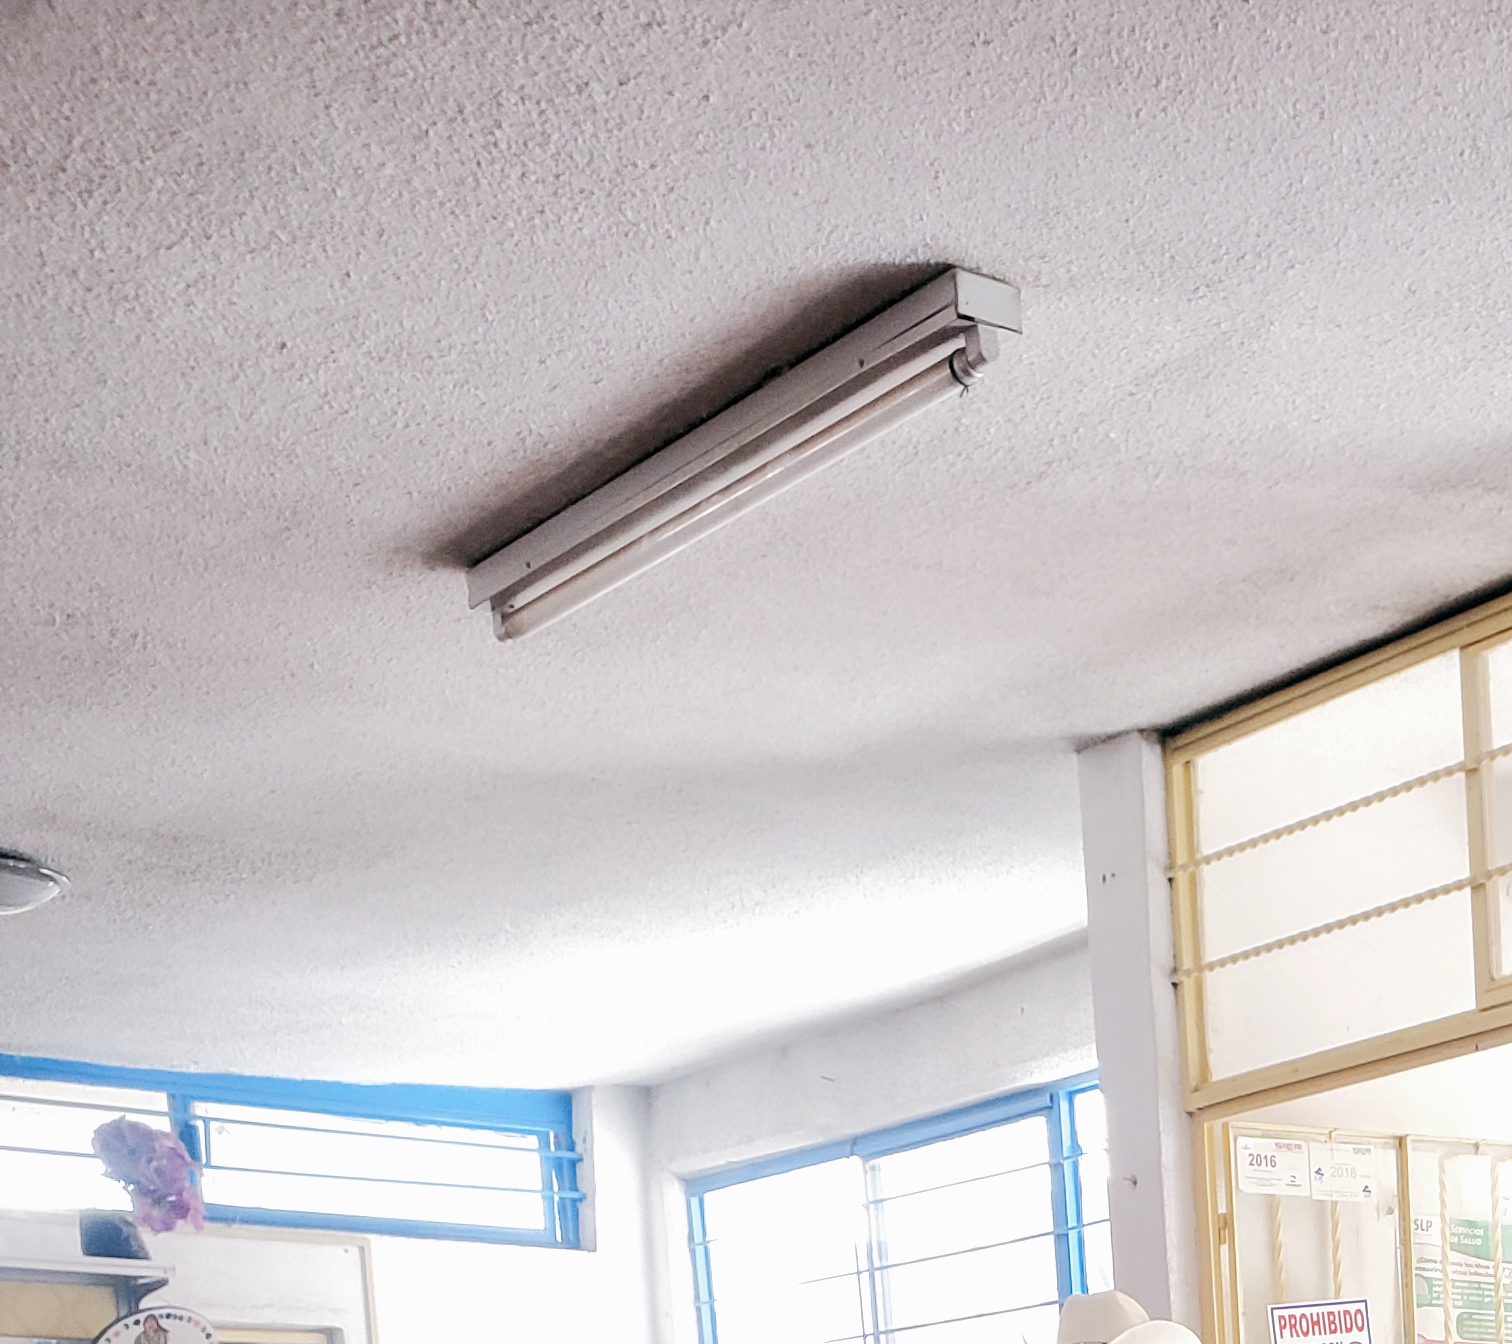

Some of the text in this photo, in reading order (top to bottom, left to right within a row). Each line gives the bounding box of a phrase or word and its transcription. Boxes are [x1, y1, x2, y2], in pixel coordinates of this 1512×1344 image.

[1248, 1153, 1277, 1168] 2016
[1330, 1166, 1357, 1179] 2018
[1413, 1218, 1433, 1232] SLP
[1278, 1309, 1365, 1339] PROHIBIDO
